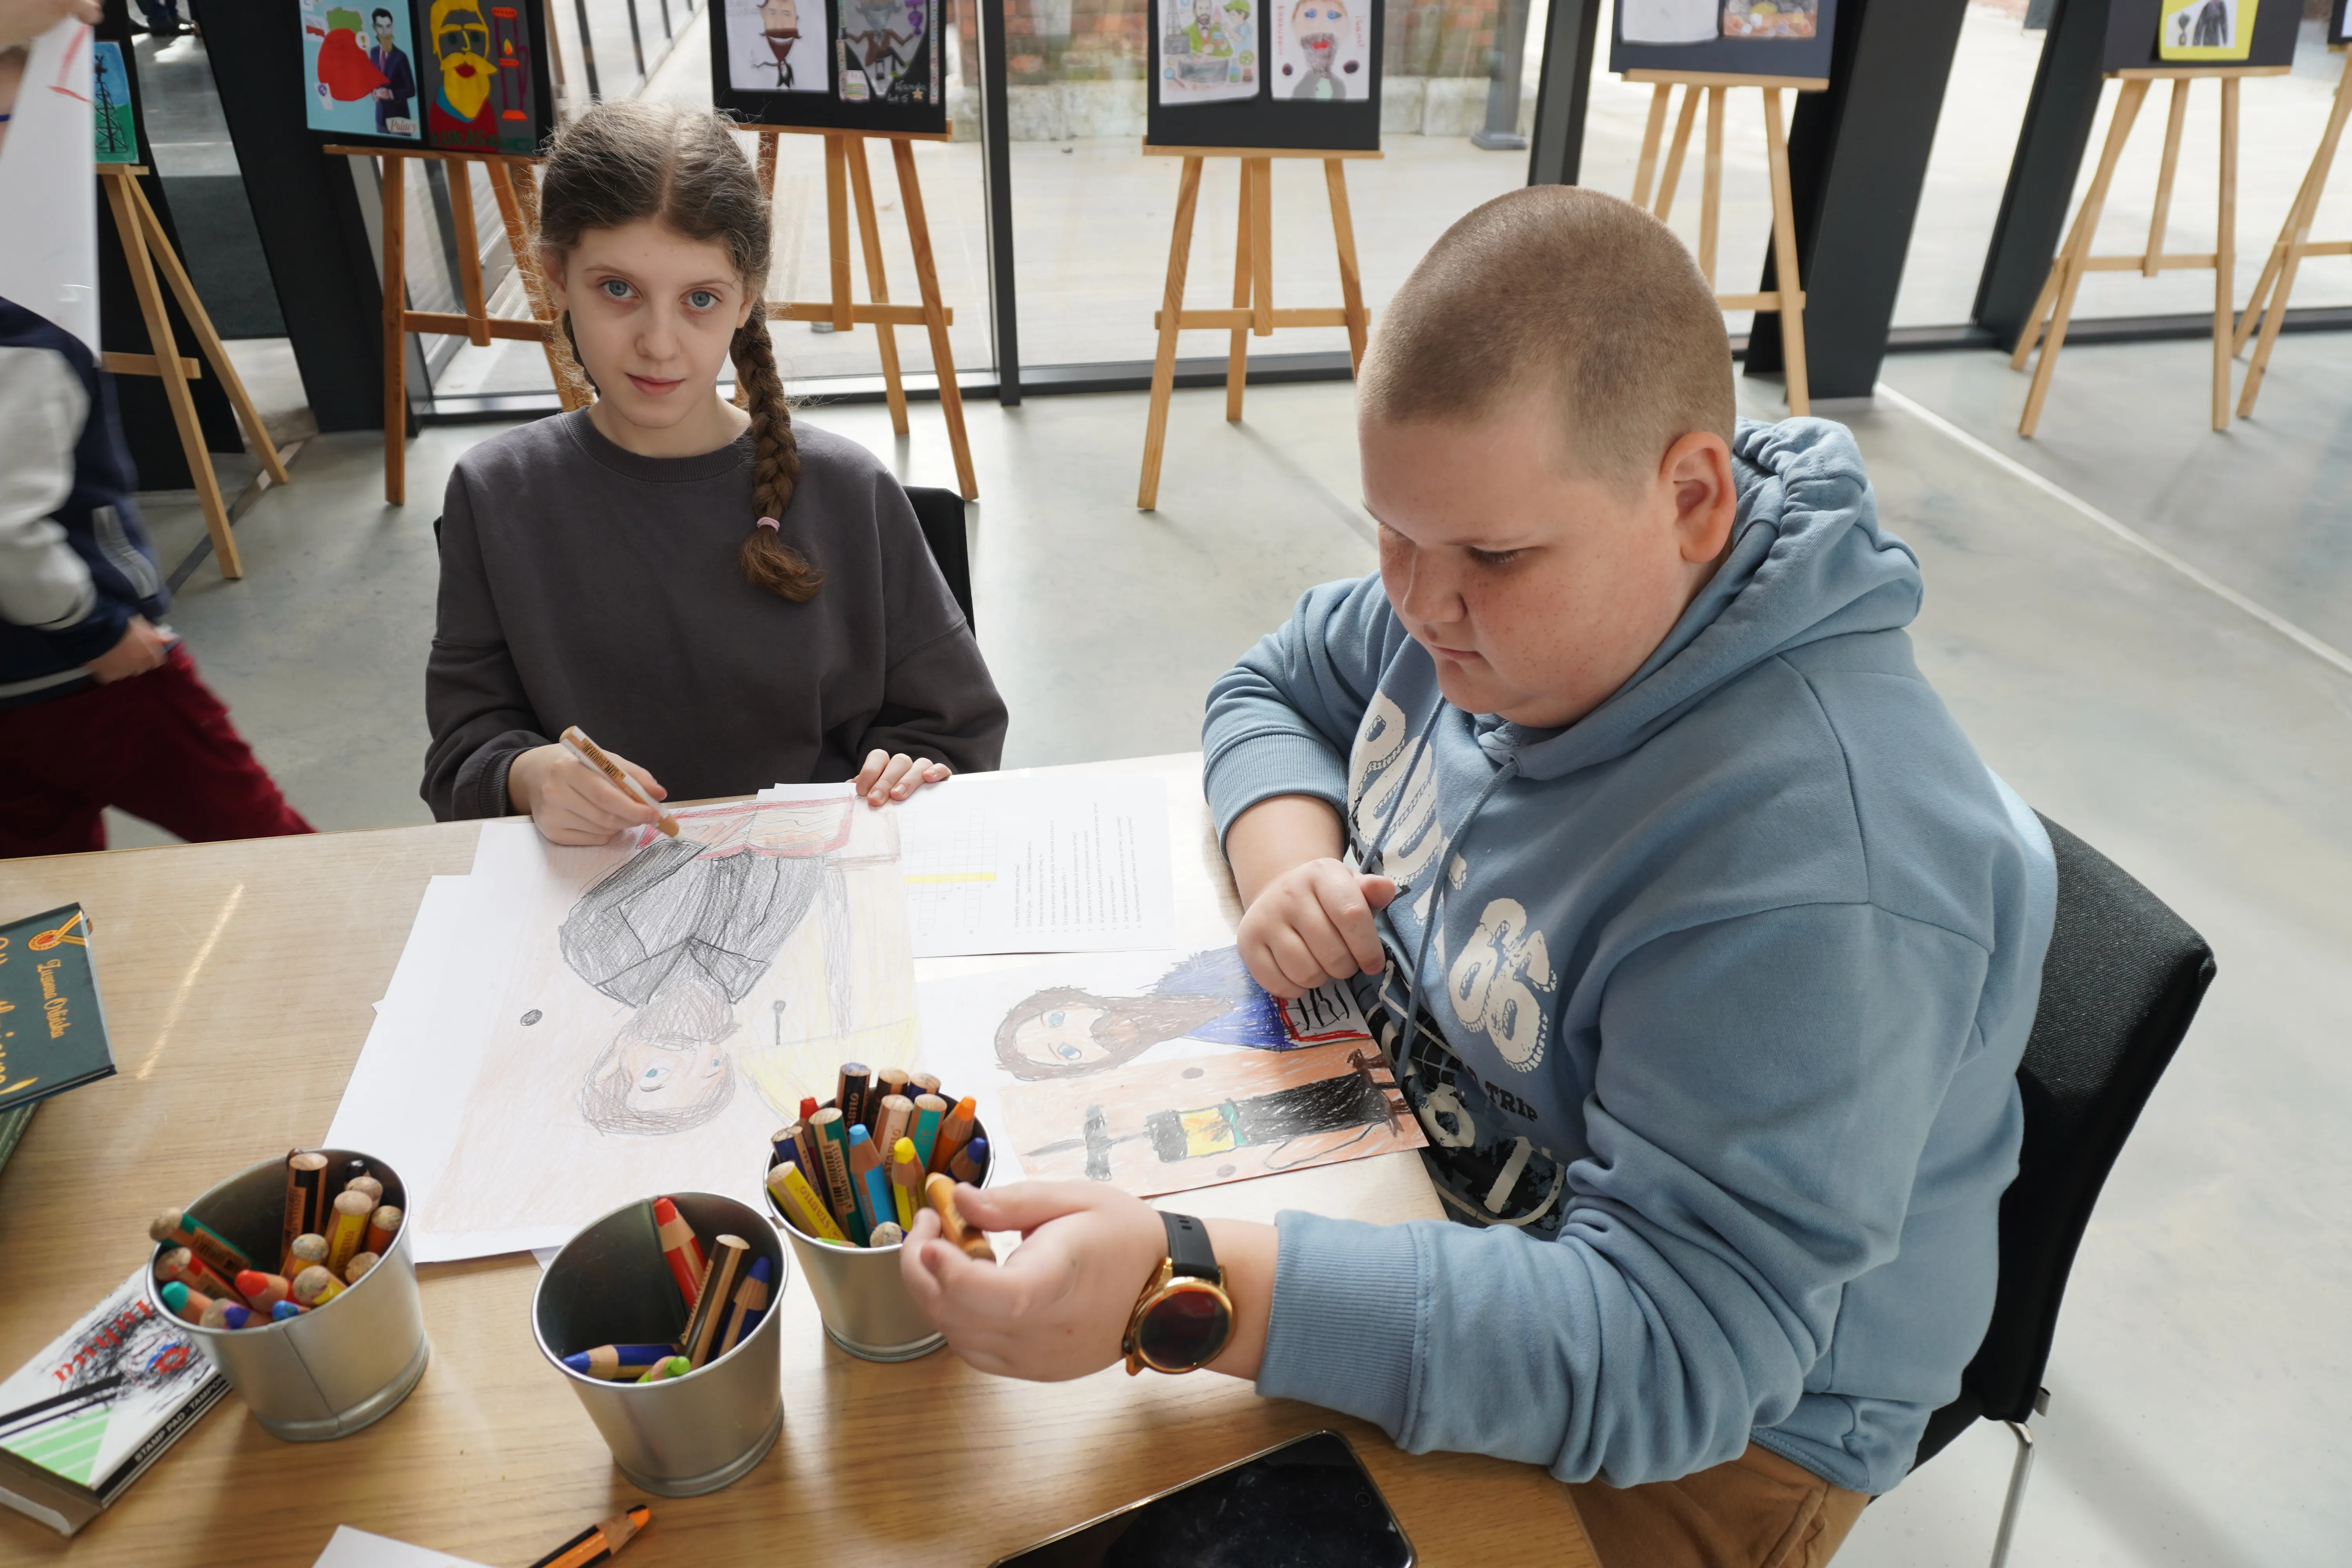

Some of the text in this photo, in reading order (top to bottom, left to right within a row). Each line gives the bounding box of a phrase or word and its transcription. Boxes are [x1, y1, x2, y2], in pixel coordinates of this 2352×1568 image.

[1448, 897, 1557, 1073] 66
[1485, 1080, 1538, 1122] TRIP
[800, 1185, 831, 1229] STABILO
[134, 1429, 166, 1463] STAMP
[166, 1412, 186, 1436] PAD
